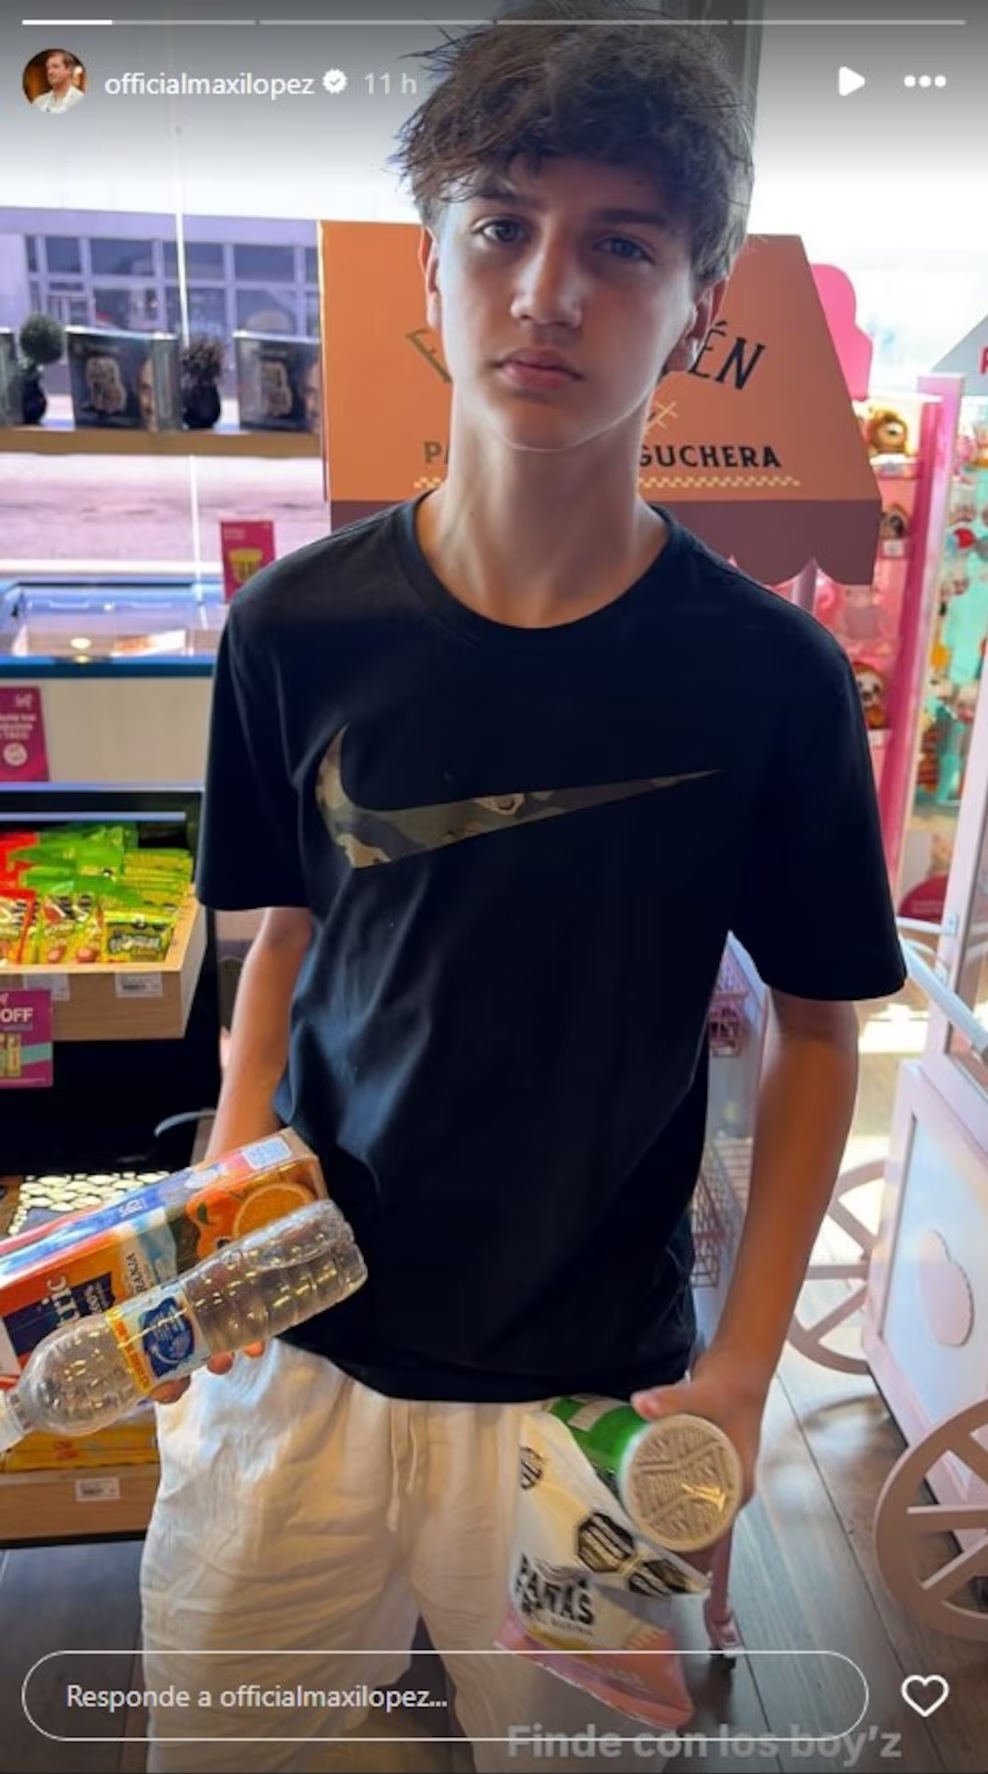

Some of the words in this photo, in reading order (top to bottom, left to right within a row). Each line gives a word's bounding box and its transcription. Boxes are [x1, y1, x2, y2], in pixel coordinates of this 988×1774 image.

[687, 320, 767, 391] ÉN
[639, 443, 782, 469] GUCHERA
[0, 1007, 34, 1023] OFF
[124, 1252, 149, 1294] RANJA
